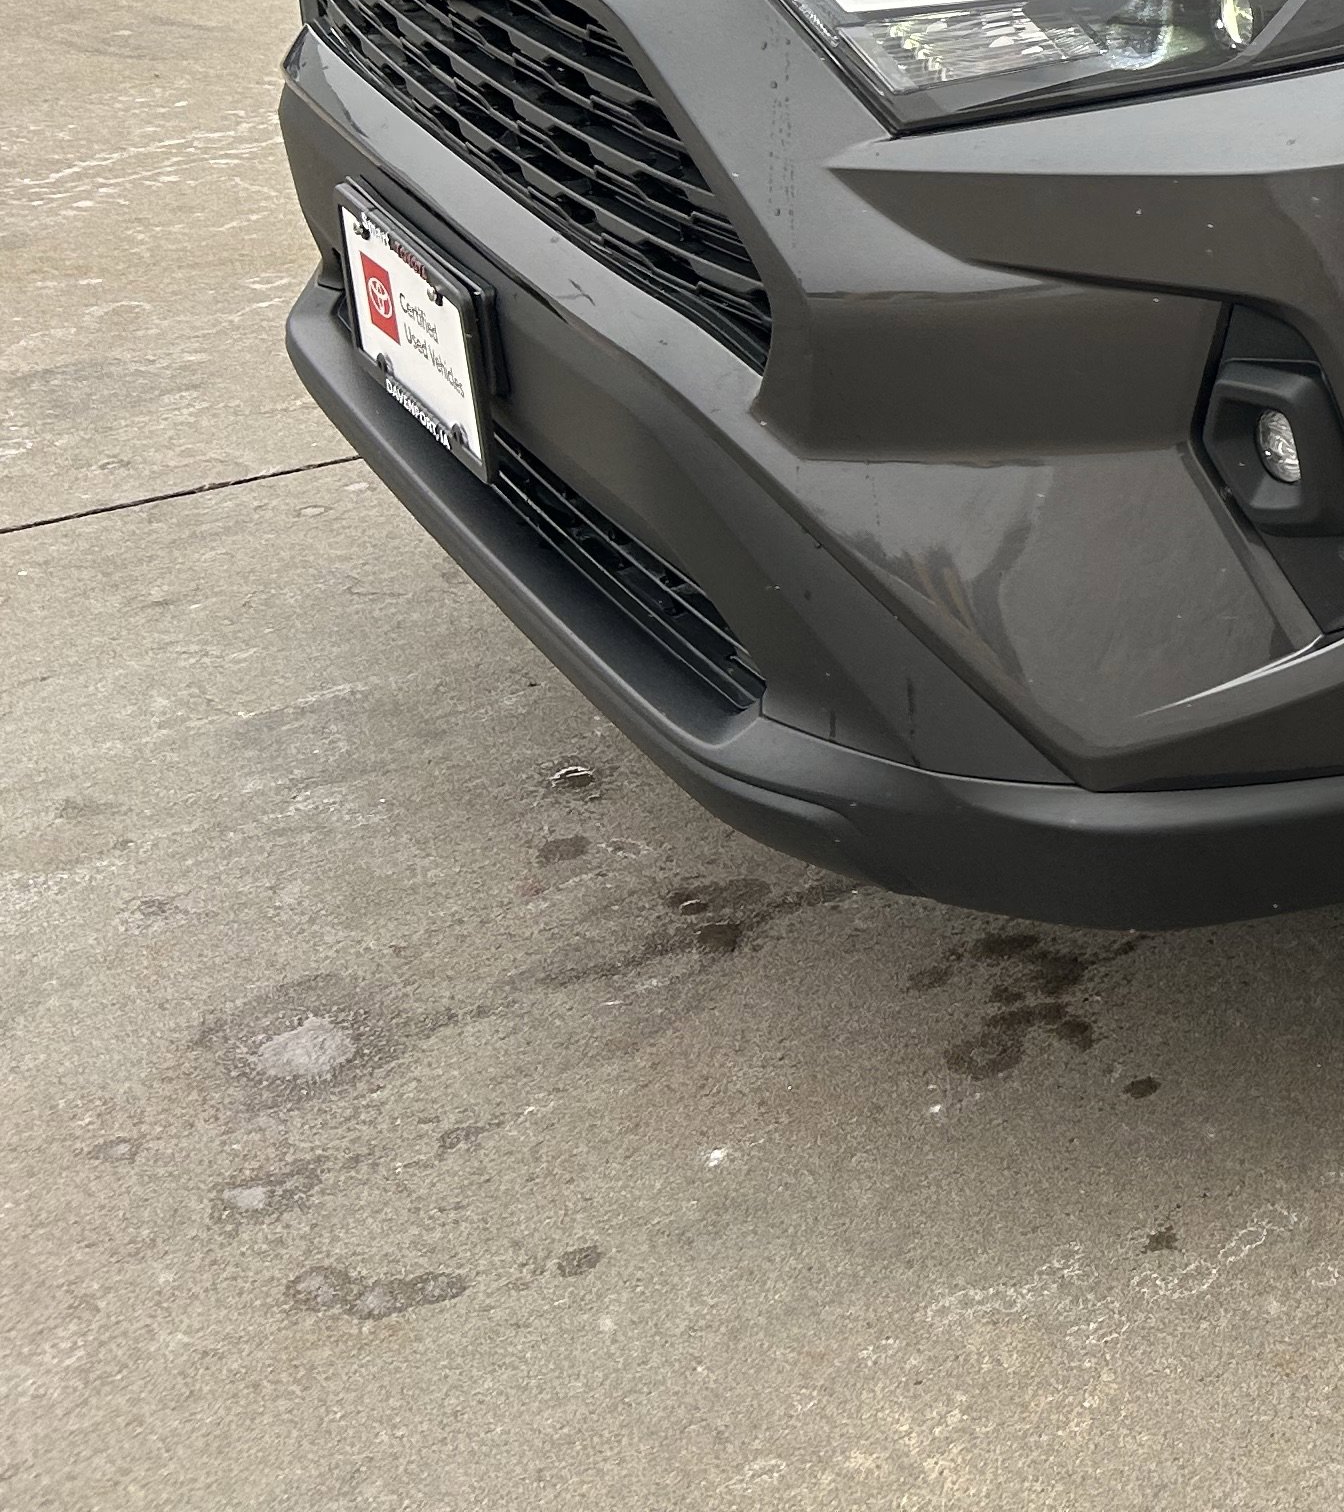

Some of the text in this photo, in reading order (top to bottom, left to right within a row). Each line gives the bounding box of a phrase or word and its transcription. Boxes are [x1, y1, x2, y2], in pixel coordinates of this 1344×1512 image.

[400, 292, 439, 345] Certified
[403, 322, 465, 399] Used Vehicles
[385, 378, 451, 450] DAVENPORT, IA
